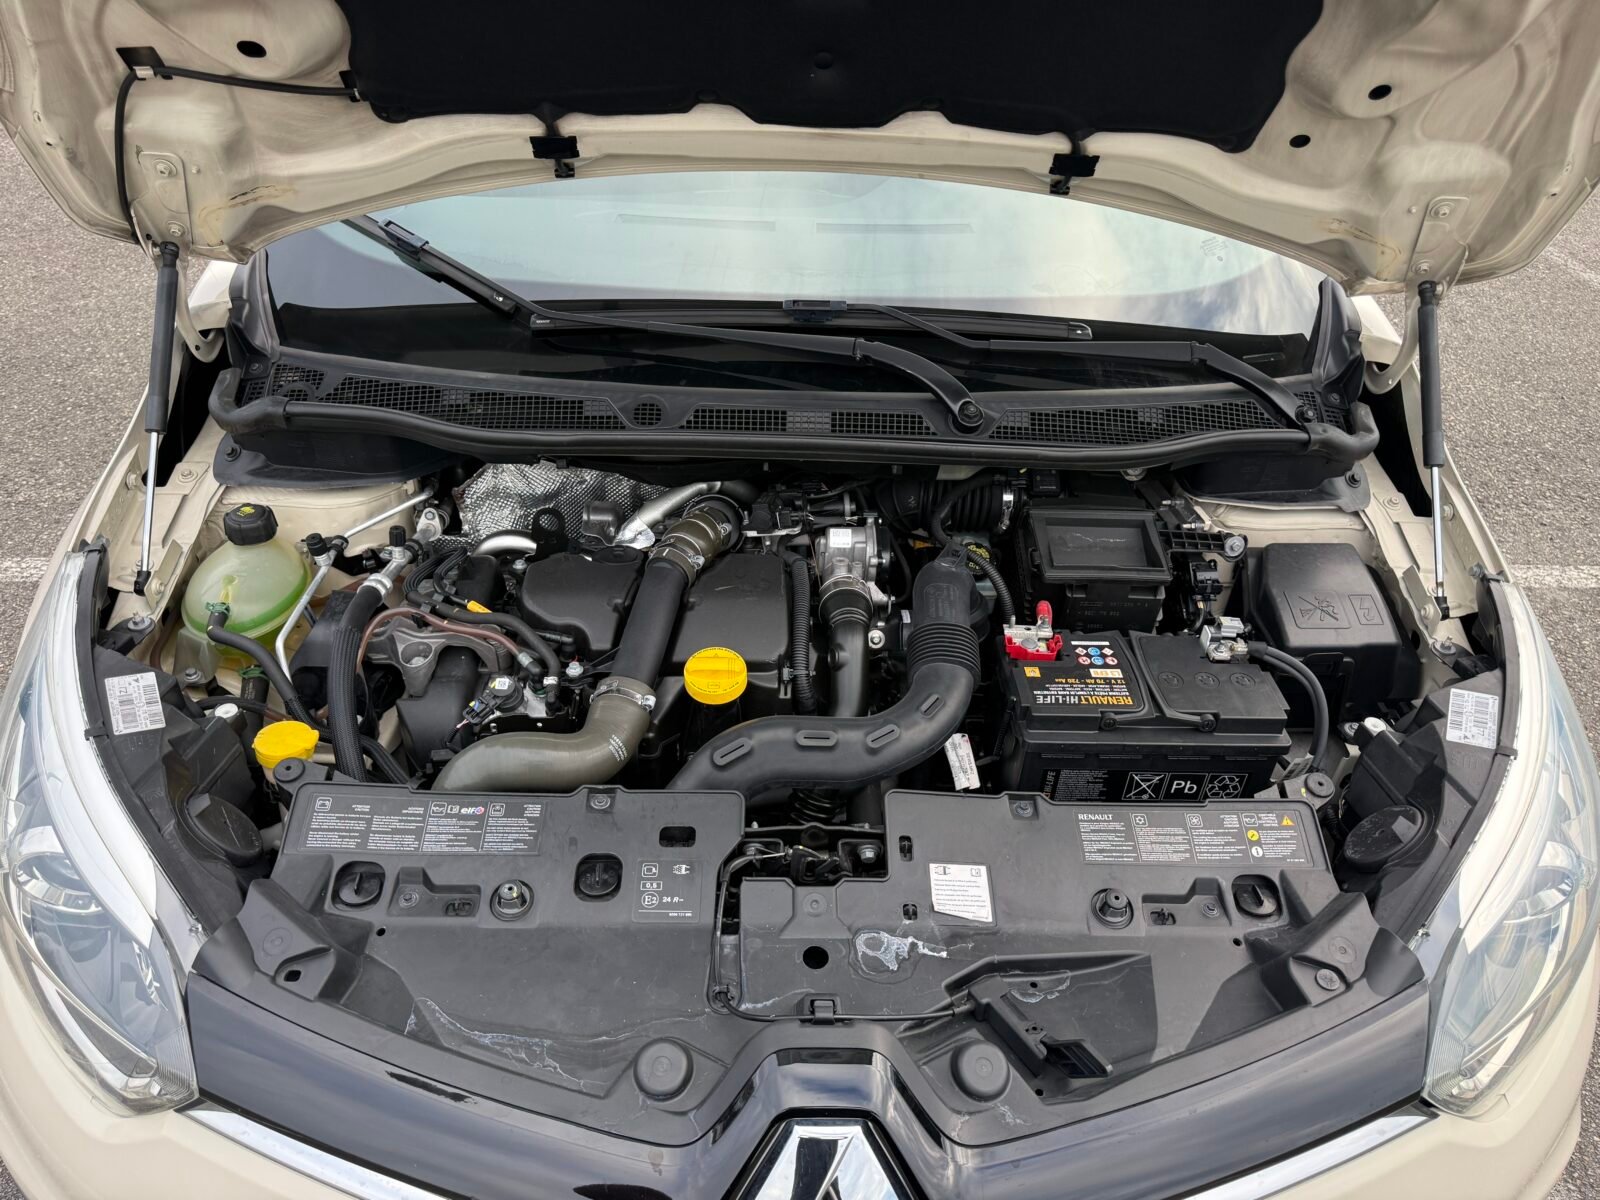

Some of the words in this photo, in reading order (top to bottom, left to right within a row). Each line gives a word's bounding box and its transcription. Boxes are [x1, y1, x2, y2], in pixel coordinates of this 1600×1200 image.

[1080, 696, 1134, 704] RENAULT
[1170, 780, 1198, 794] Pb
[460, 806, 476, 814] elf
[644, 895, 657, 904] E2
